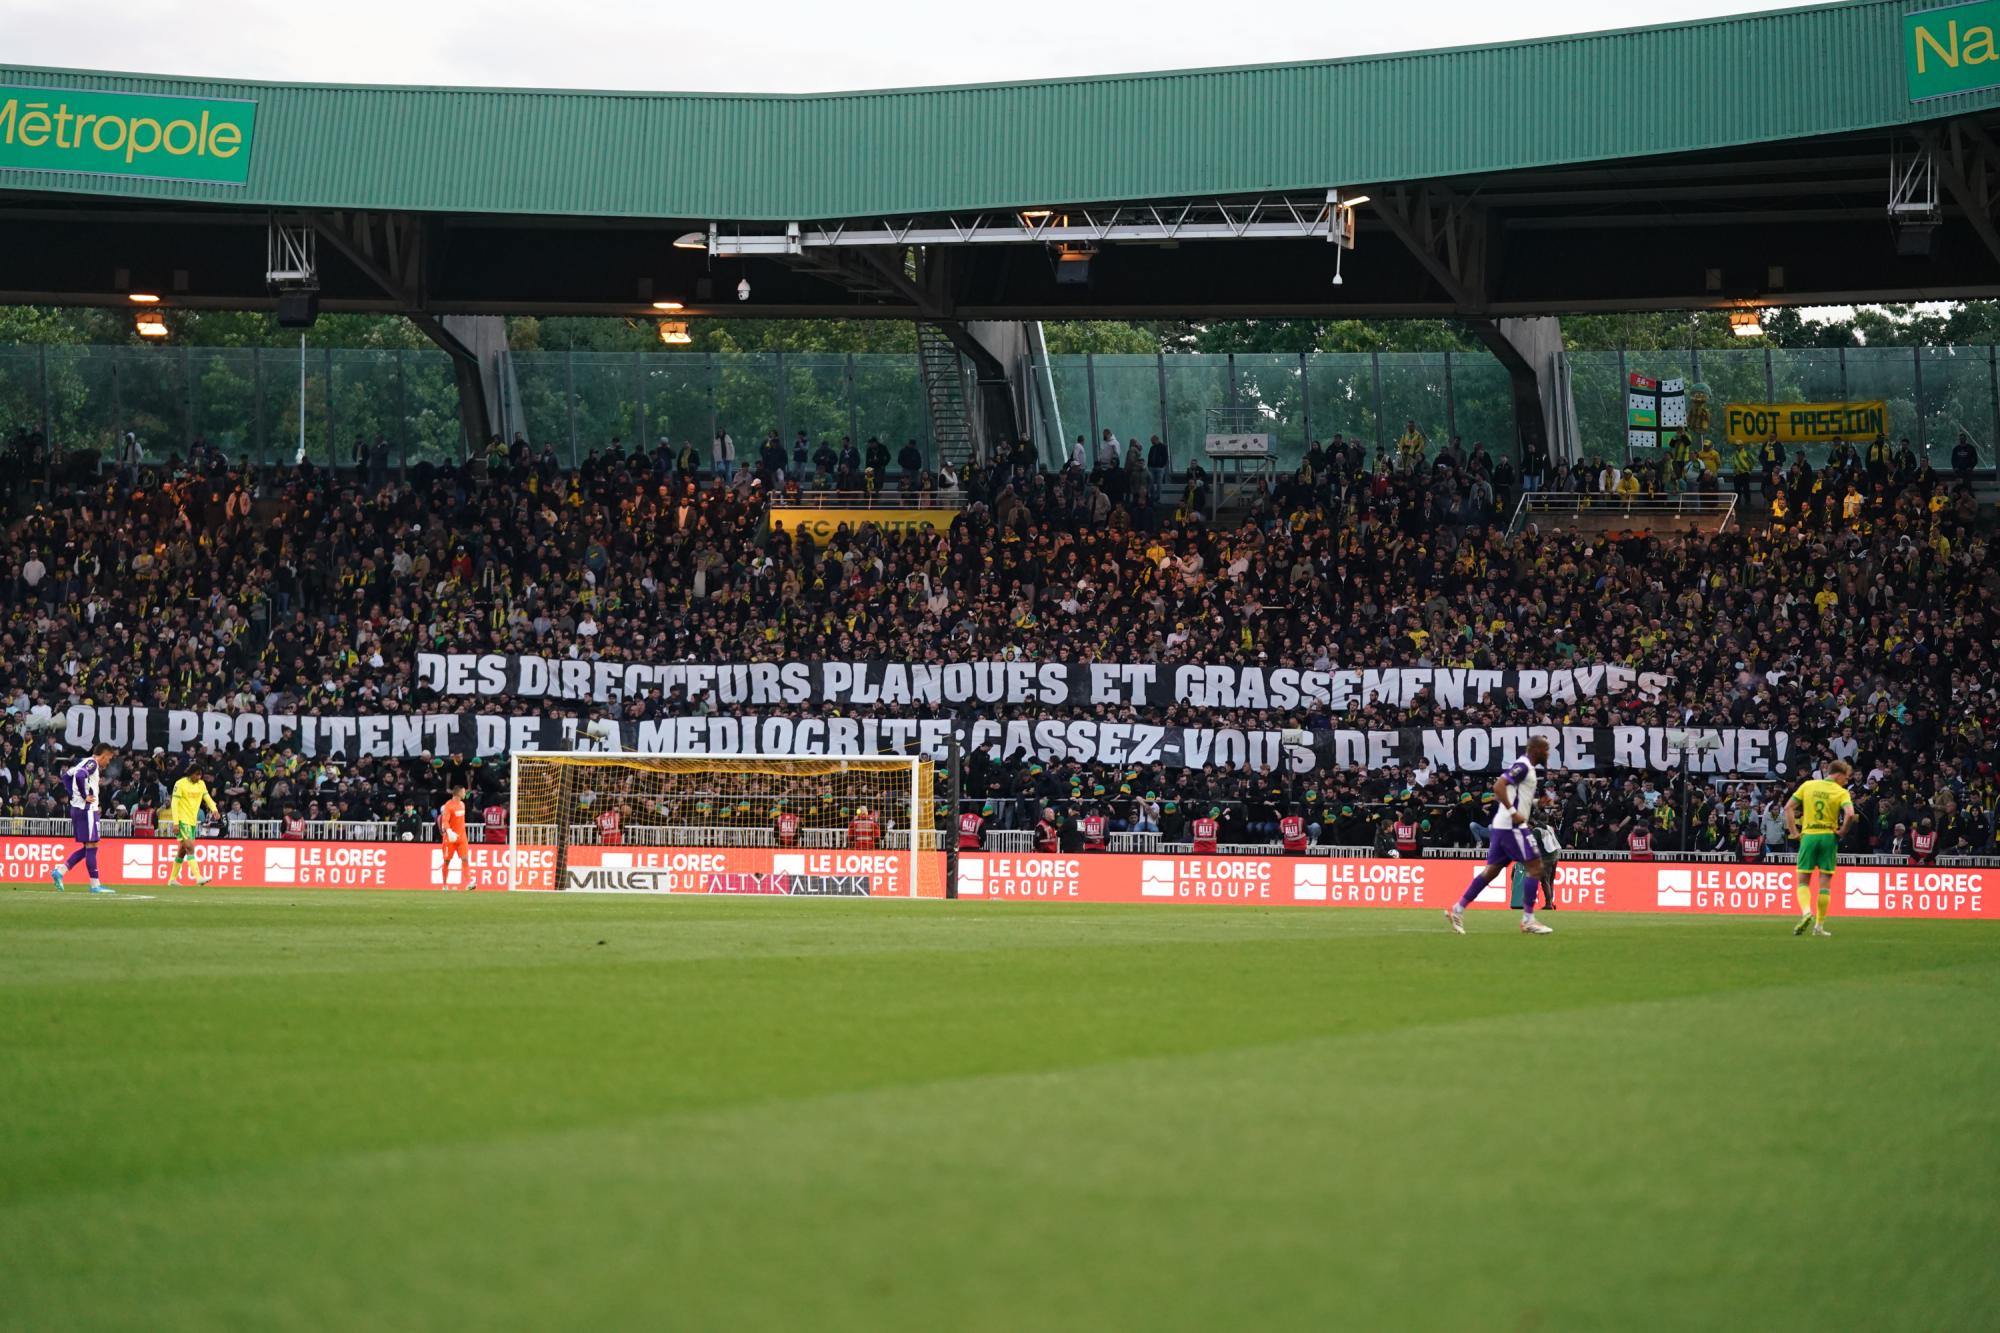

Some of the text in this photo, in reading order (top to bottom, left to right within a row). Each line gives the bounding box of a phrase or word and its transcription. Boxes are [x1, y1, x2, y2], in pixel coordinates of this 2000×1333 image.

[1729, 408, 1883, 436] FOOT PASSION
[417, 653, 506, 695] DES
[518, 655, 811, 704] DIRECTEURS
[823, 661, 1069, 705] PLANQUES
[1090, 663, 1156, 705] ET
[1175, 664, 1503, 711] GRASSEMENT
[65, 705, 149, 751] QUI
[168, 710, 459, 758] PROFITENT
[476, 715, 541, 757] DE
[1335, 730, 1399, 771] DE
[1422, 726, 1595, 772] NOTRE
[1815, 800, 1825, 820] 3
[5, 843, 65, 860] LOREC
[158, 844, 244, 863] LE OREC
[300, 848, 387, 867] LE LOREC
[468, 850, 488, 867] LE
[0, 863, 62, 878] OUP
[638, 853, 726, 871] LE LOREC
[810, 855, 898, 874] LE LOREC
[989, 860, 1080, 879] LE LOREC
[1180, 861, 1271, 880] LE LOREC
[158, 864, 243, 880] GUPE
[300, 868, 386, 884] GROUPE
[569, 871, 667, 890] MILLET
[1332, 864, 1425, 884] LE LOREC
[1553, 867, 1606, 886] OREC
[1697, 870, 1793, 891] LE LOREC
[709, 874, 788, 896] ALTYK
[790, 874, 869, 896] ALTYK
[989, 879, 1079, 897] GROUPE
[1180, 881, 1270, 898] GROUPE
[1885, 872, 1982, 893] LE LOREC
[1332, 885, 1424, 902] GROUPE
[1697, 892, 1792, 909] GROUPE
[1885, 894, 1981, 911] GROUPE
